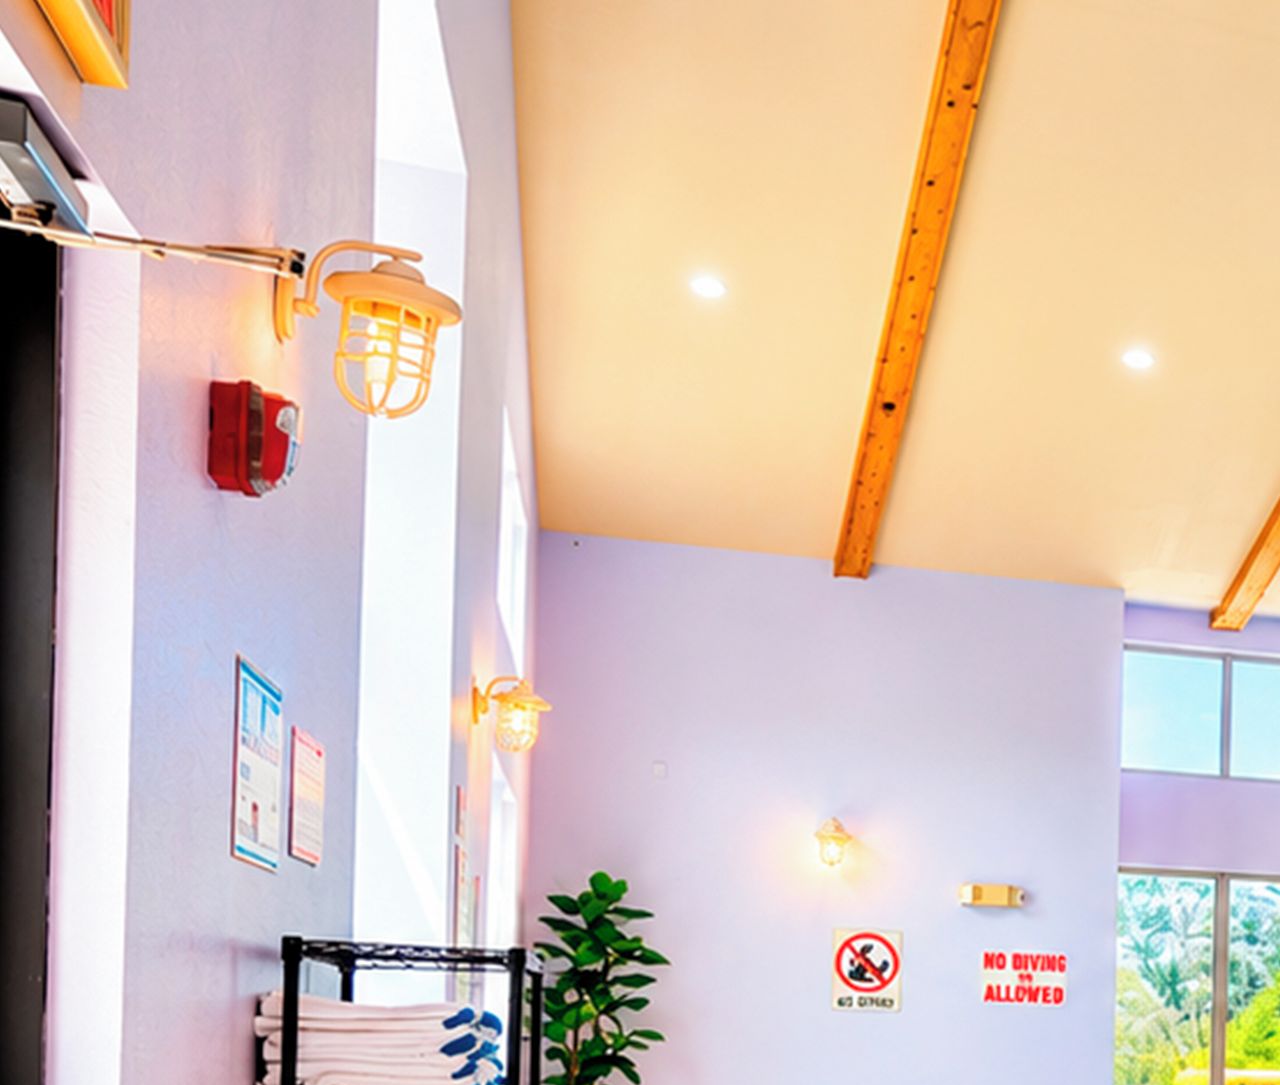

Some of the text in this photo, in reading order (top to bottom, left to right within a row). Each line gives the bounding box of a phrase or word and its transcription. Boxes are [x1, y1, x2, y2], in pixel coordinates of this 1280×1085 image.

[983, 952, 1066, 973] NO DIVING
[984, 984, 1063, 1004] ALLOWED
